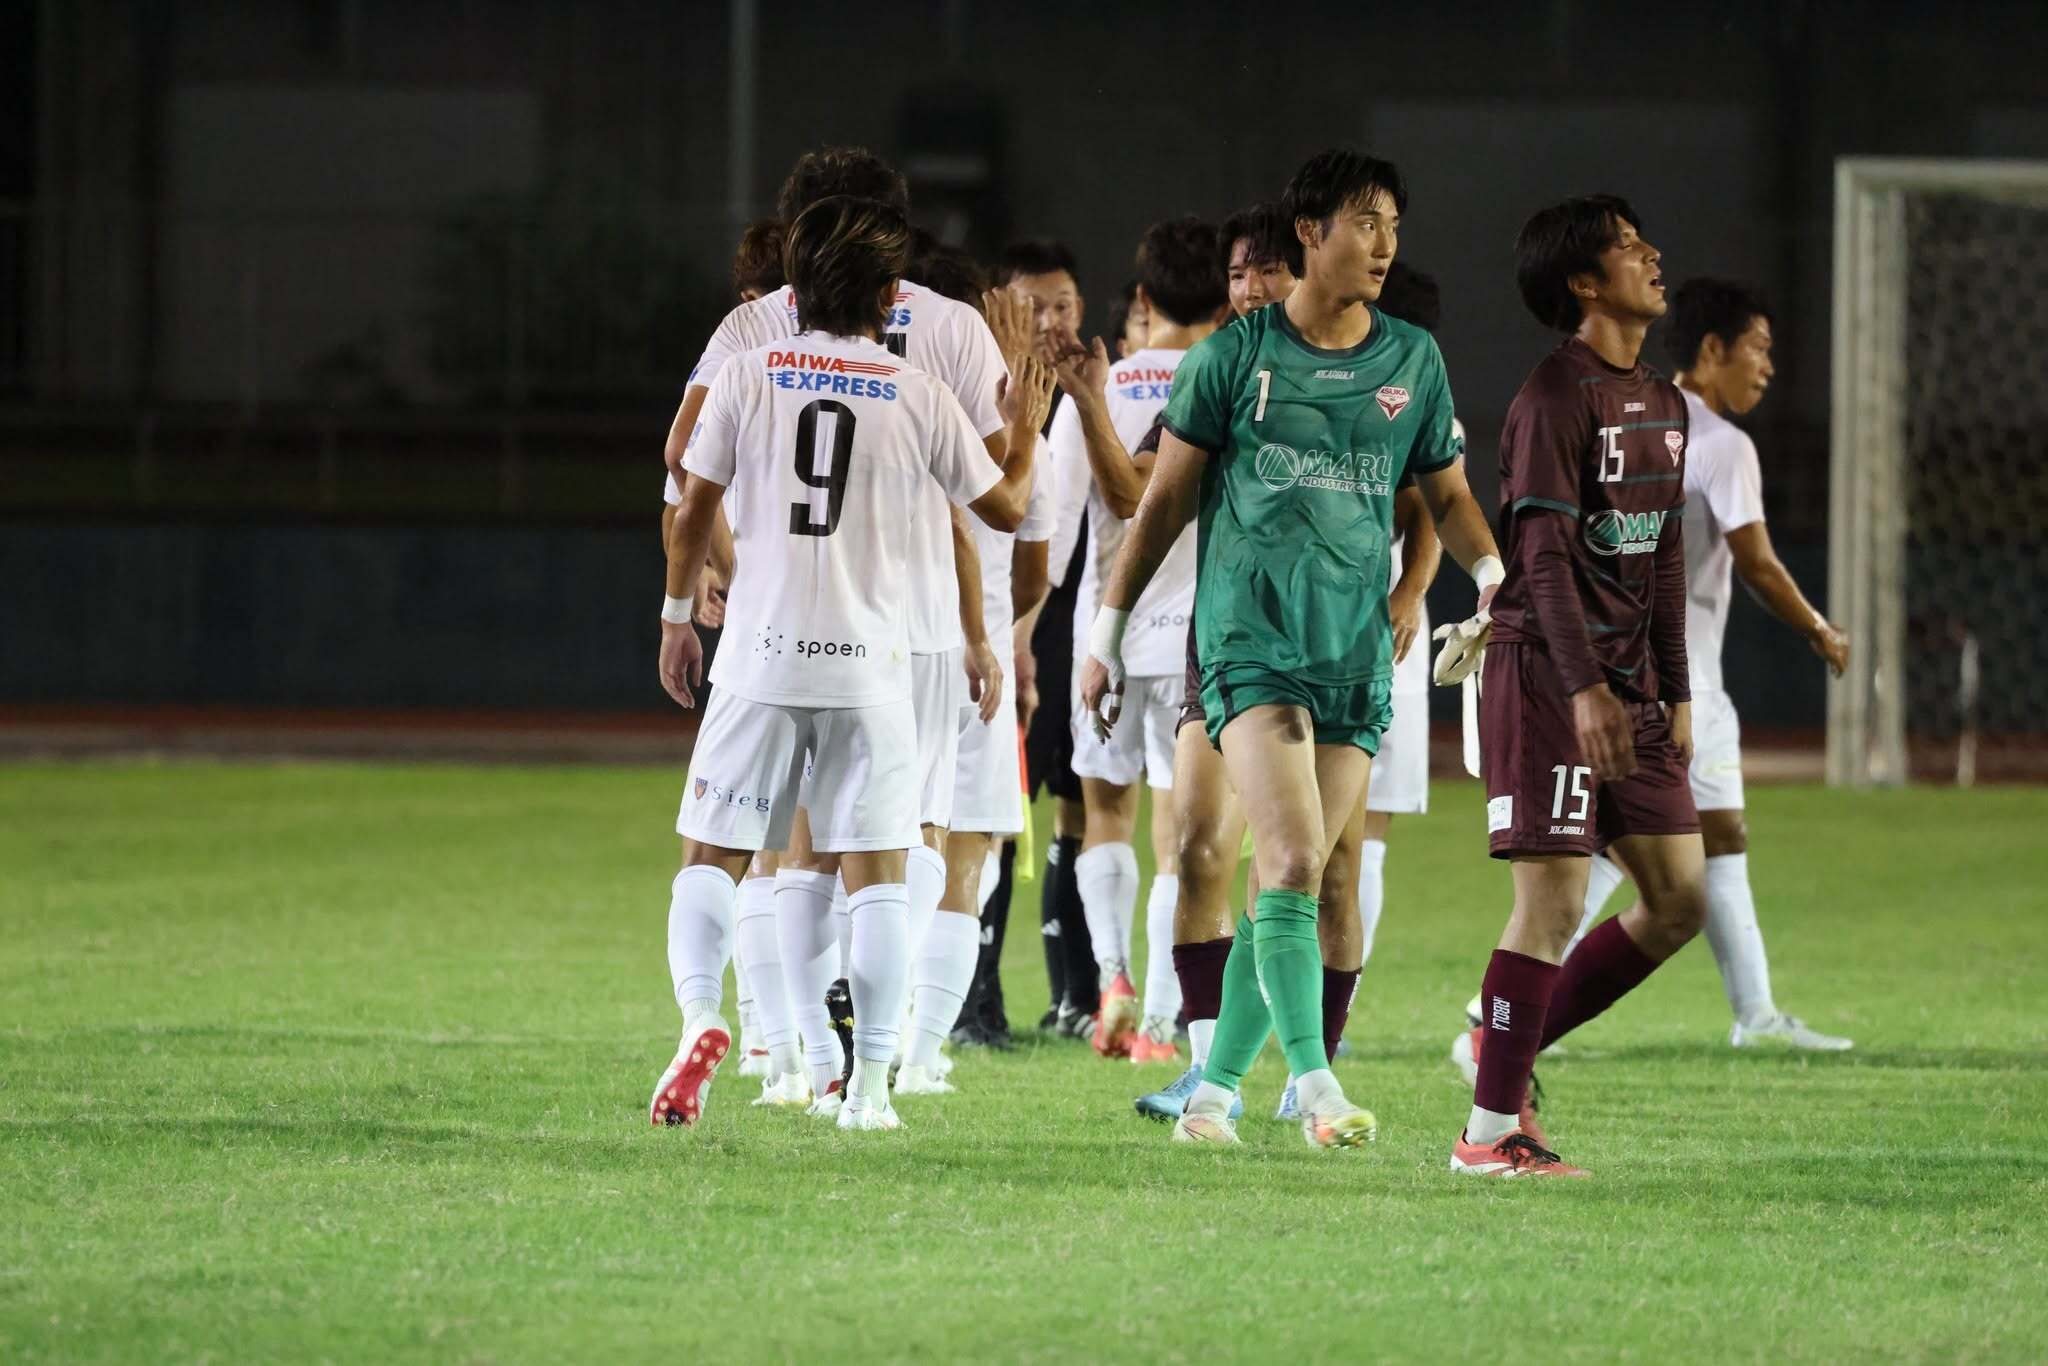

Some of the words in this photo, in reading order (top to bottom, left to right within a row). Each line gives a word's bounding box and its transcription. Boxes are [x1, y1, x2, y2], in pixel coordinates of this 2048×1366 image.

[767, 351, 846, 373] DAIWA
[775, 370, 897, 401] EXPRESS
[1255, 370, 1271, 421] 1
[789, 399, 857, 536] 9
[1597, 426, 1625, 482] 15
[1622, 511, 1668, 541] MA
[797, 640, 866, 658] spoen
[712, 785, 769, 812] Sieg
[1552, 765, 1592, 820] 15
